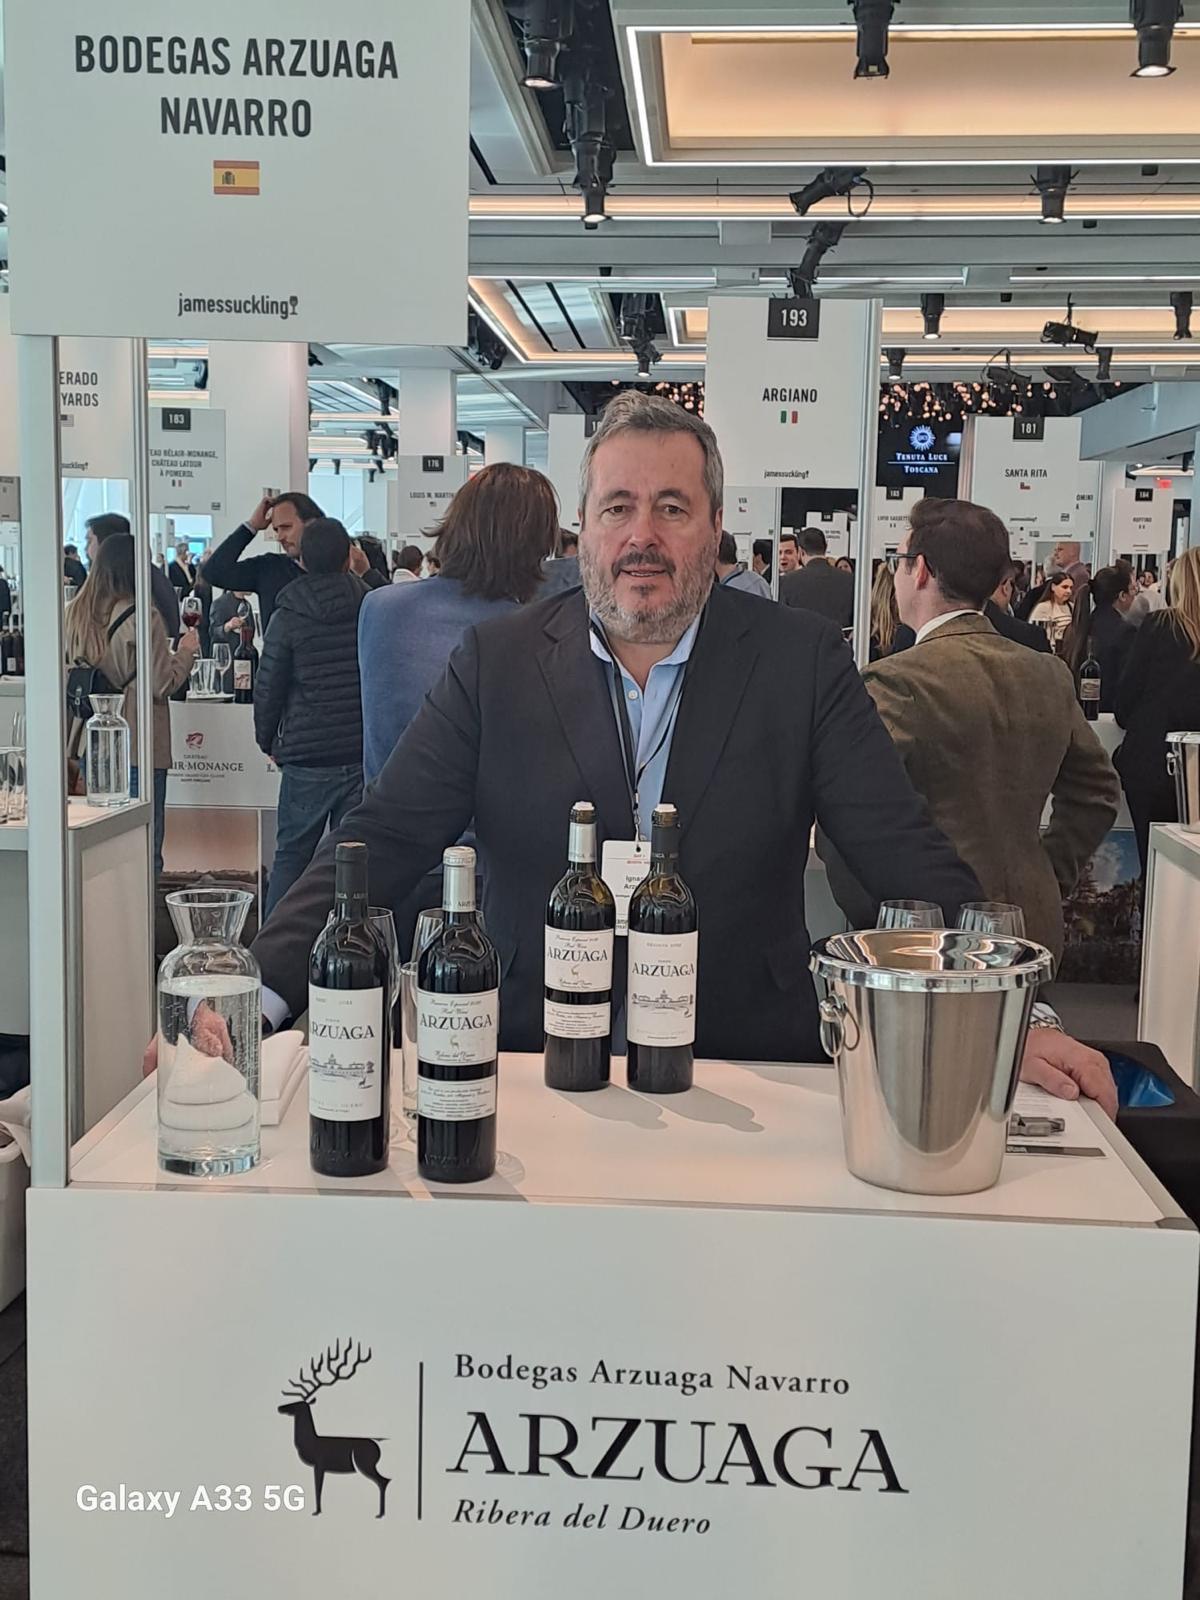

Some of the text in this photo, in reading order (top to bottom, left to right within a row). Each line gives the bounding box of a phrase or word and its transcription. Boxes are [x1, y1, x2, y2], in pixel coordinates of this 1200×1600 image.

[75, 35, 398, 79] BODEGAS ARZUAGA
[160, 97, 312, 138] NAVARRO
[177, 293, 289, 320] jamessuckling
[780, 308, 808, 327] 193
[61, 392, 99, 407] YARDS
[762, 387, 818, 403] ARGIANO
[168, 413, 185, 424] 183
[1021, 423, 1037, 434] 181
[895, 452, 948, 461] TENUTA LUCE
[904, 465, 939, 474] TOSCANA
[1005, 468, 1048, 478] SANTA RITA
[547, 945, 608, 962] ARZUAGA
[632, 962, 695, 977] ARZUAGA
[420, 1012, 492, 1031] ARZUAGA
[454, 1353, 850, 1396] Bodegas Arzuaga Navarro
[445, 1410, 910, 1494] ARZUAGA
[452, 1498, 711, 1535] Ribera del Duero
